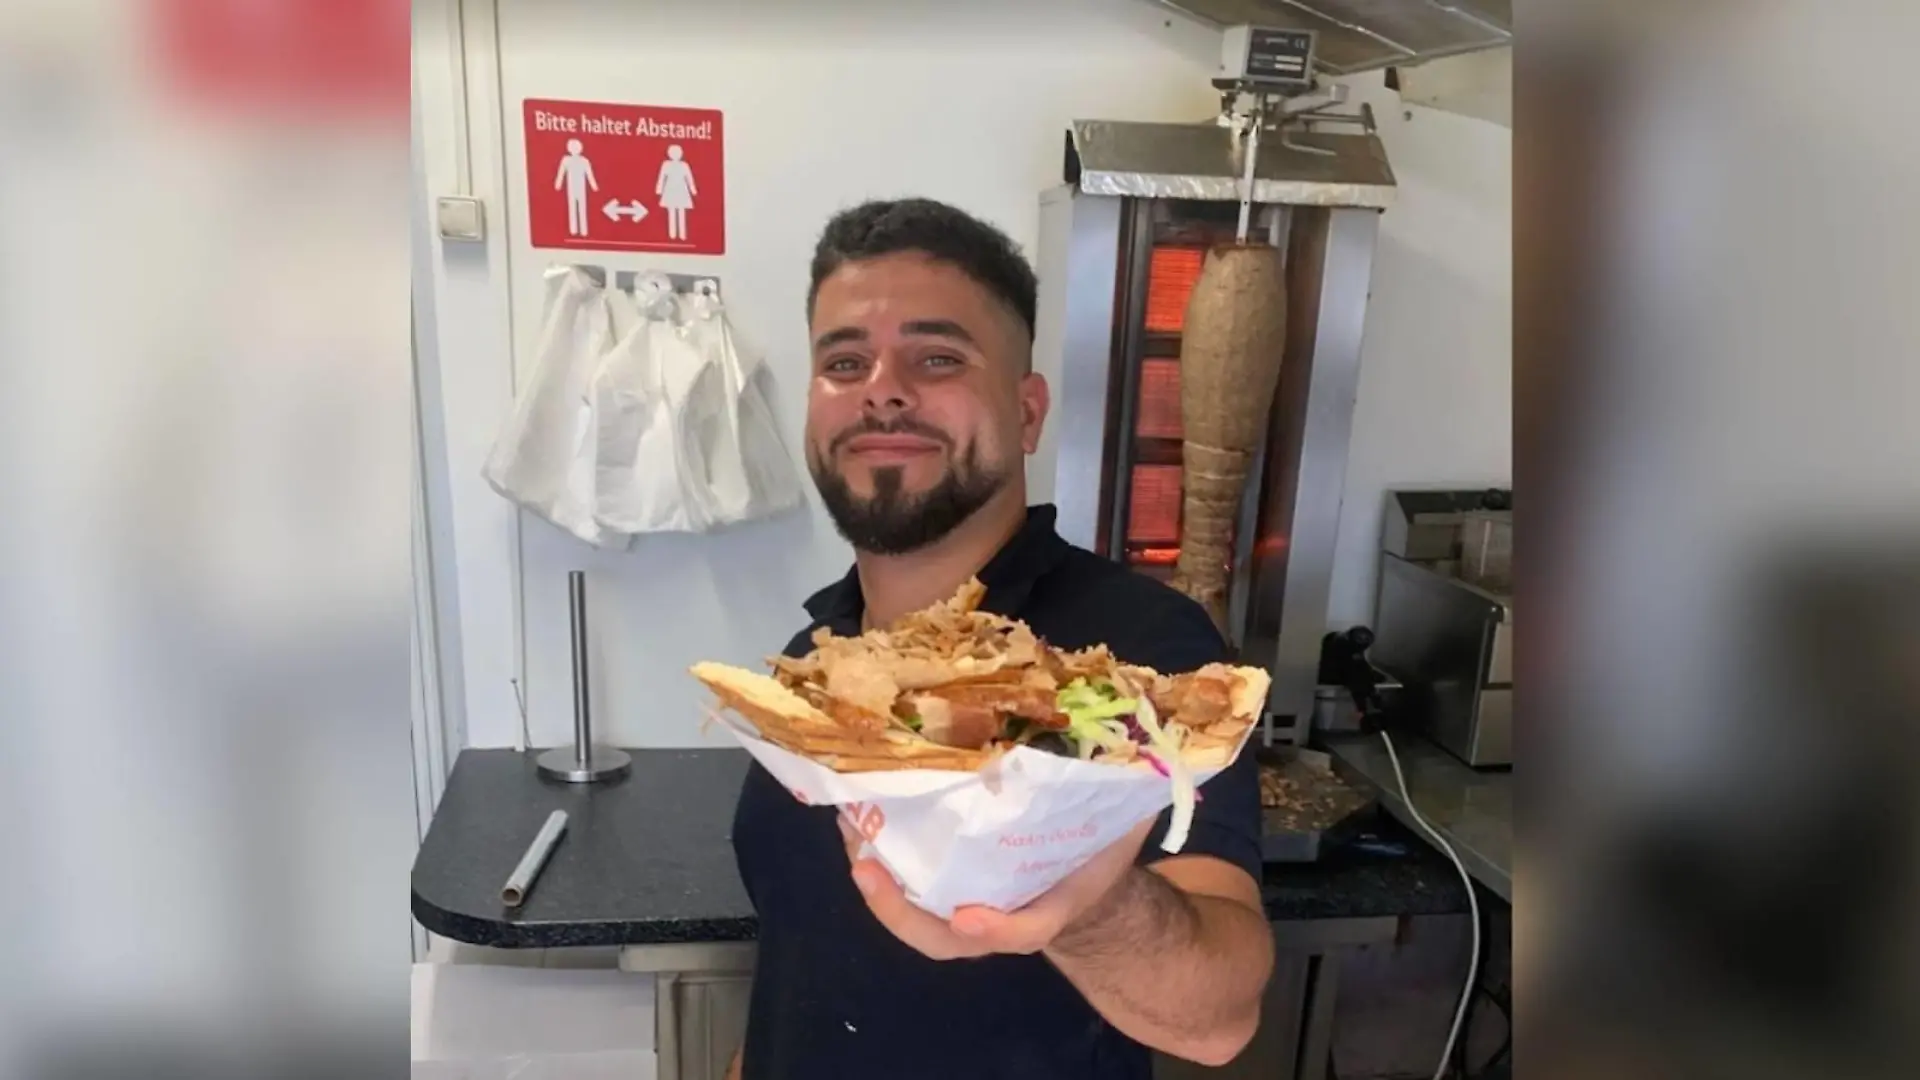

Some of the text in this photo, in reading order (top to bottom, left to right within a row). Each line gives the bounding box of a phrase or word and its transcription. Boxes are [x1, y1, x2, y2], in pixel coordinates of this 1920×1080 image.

[534, 110, 713, 140] Bitte haltet Abstand!
